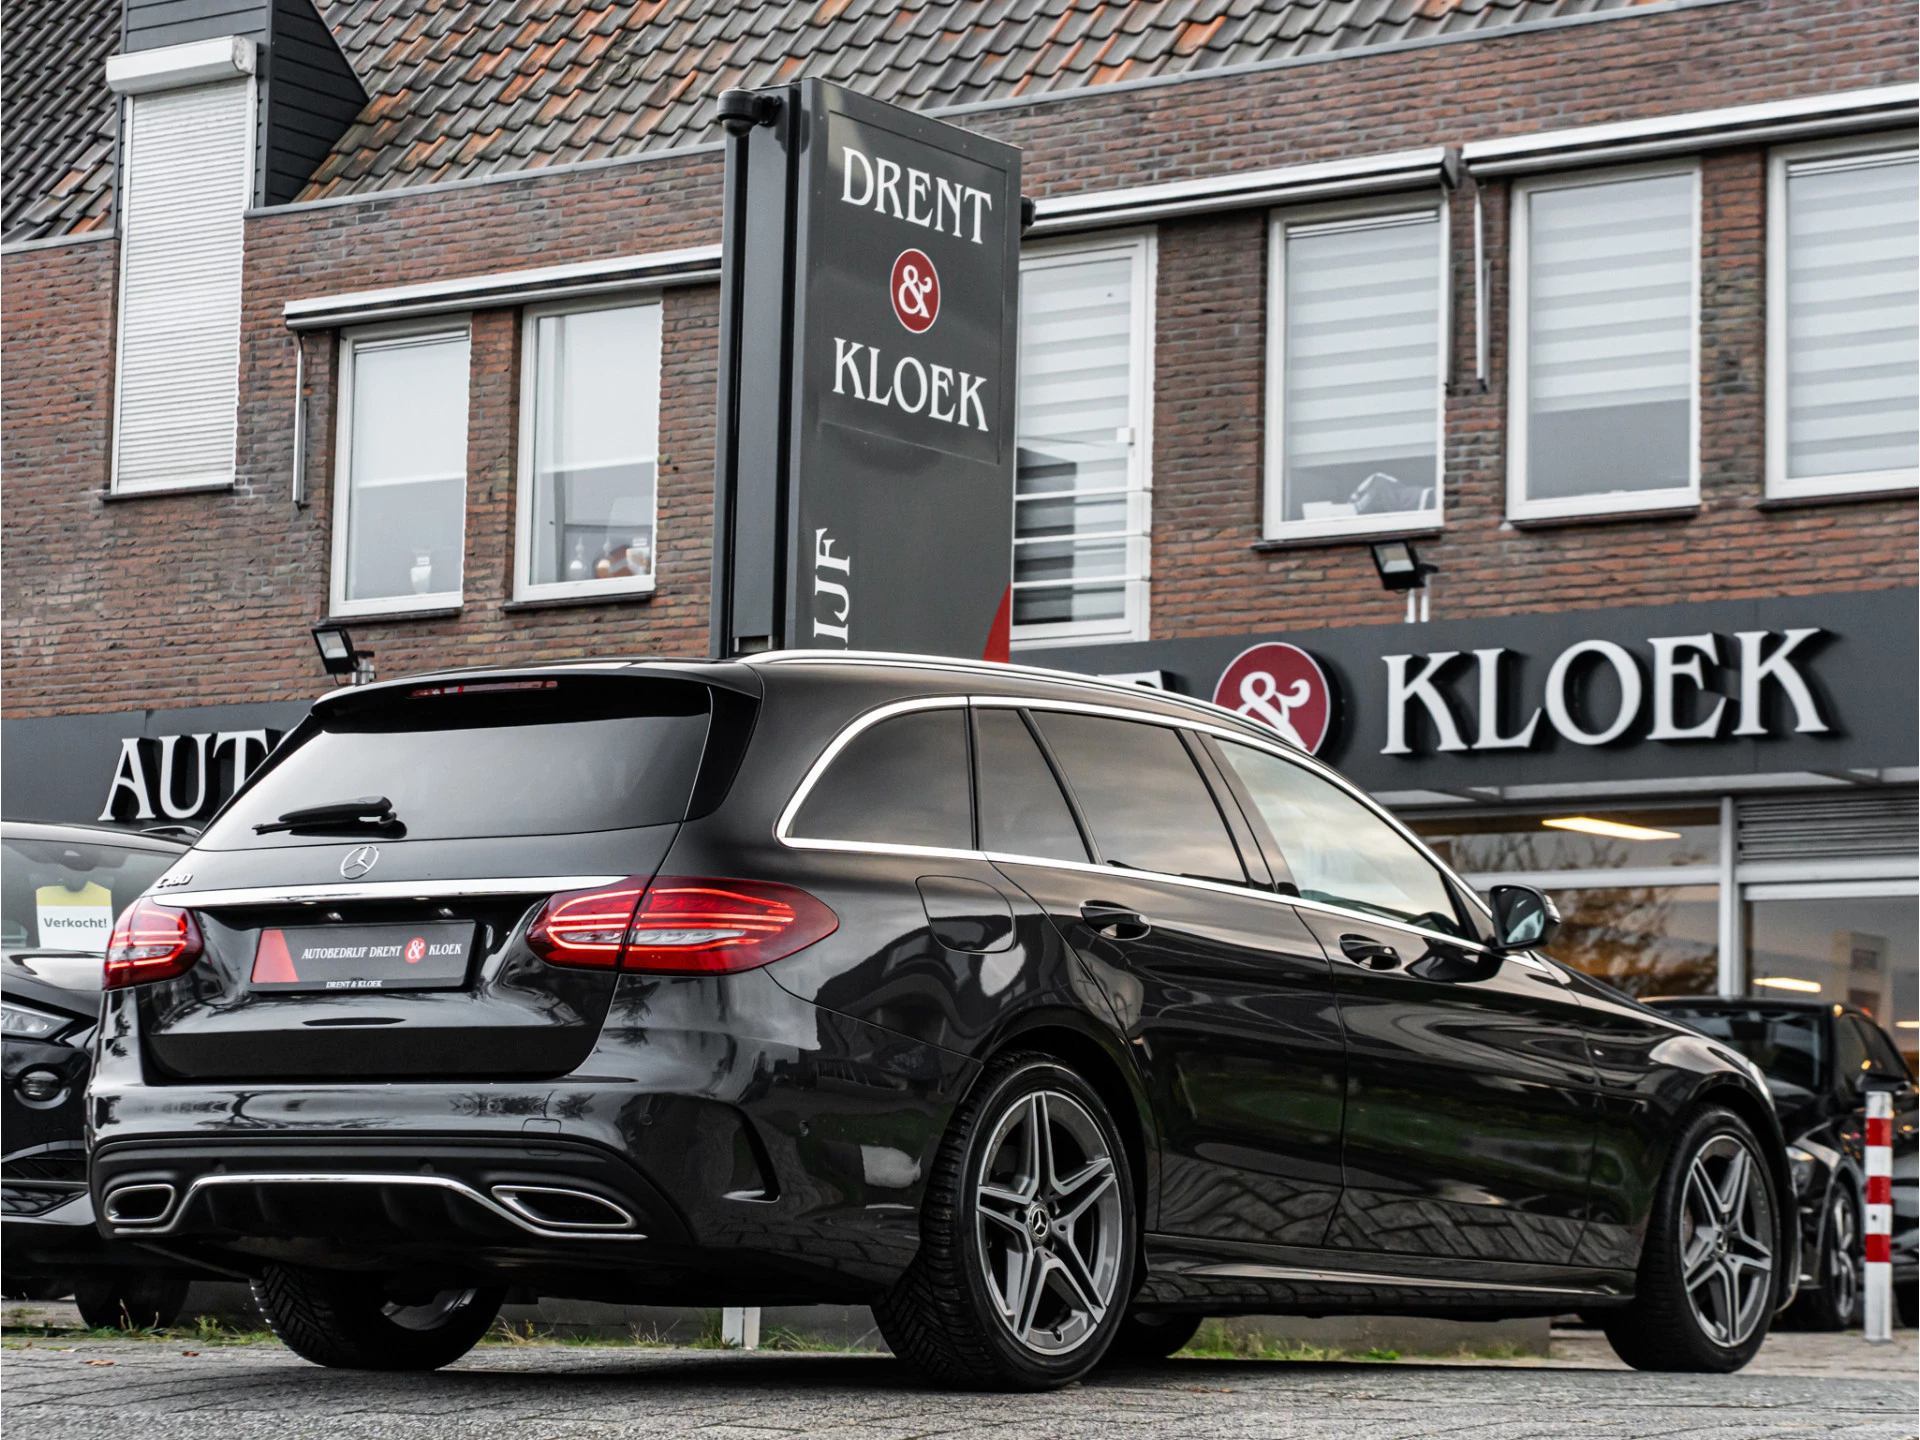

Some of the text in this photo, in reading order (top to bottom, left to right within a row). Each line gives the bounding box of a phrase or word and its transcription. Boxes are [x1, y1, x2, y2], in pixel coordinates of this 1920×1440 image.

[841, 146, 992, 245] DRENT
[899, 264, 932, 319] &
[832, 337, 989, 432] KLOEK
[813, 528, 850, 650] IJF
[1380, 628, 1830, 754] KLOEK
[43, 917, 107, 928] Verkocht!
[302, 941, 461, 959] AUTOBEDRIJF DRENT & KLOEK
[326, 980, 350, 989] DRENT
[358, 979, 382, 988] KLOEK
